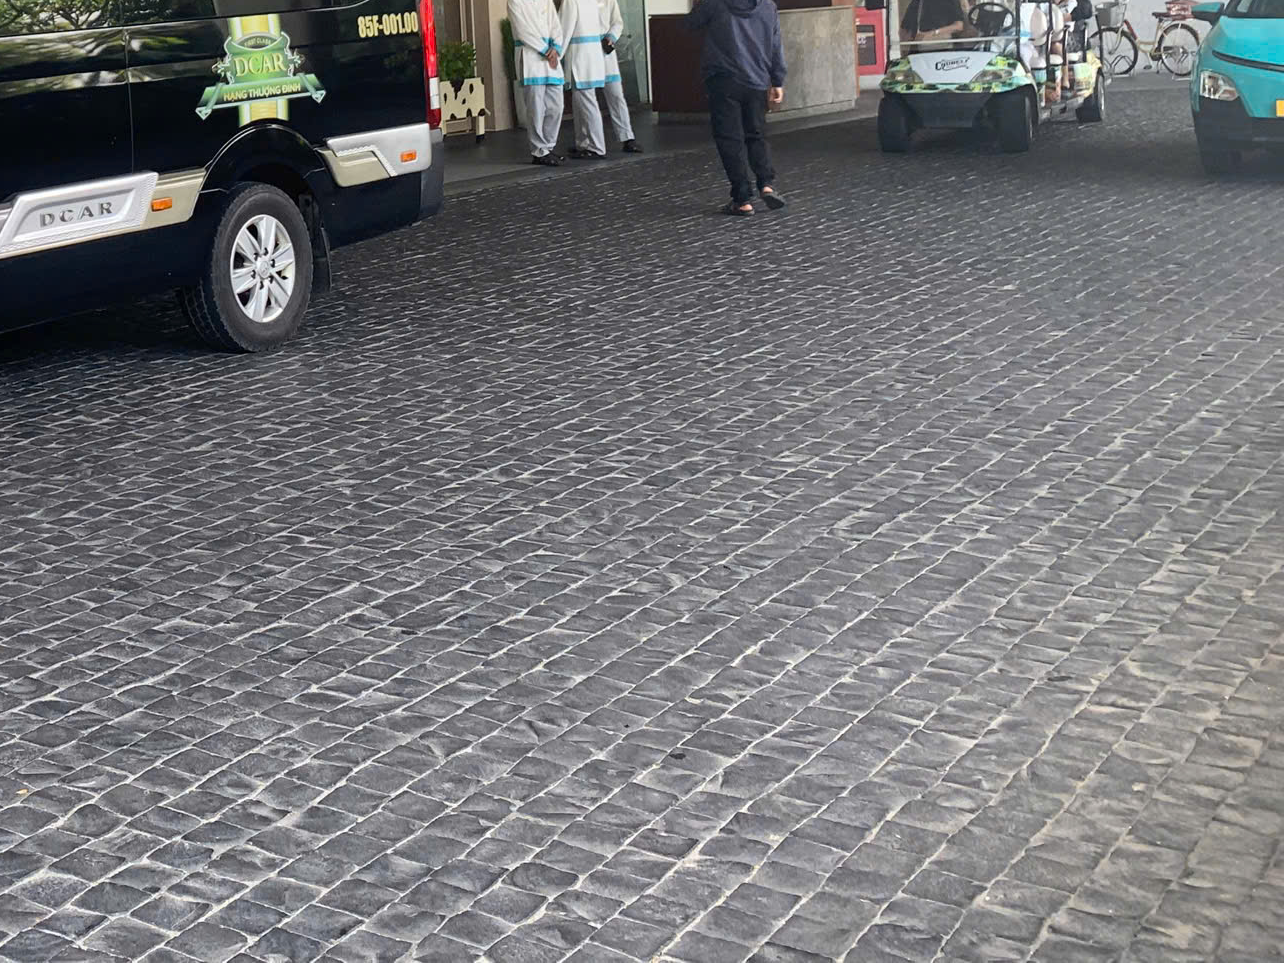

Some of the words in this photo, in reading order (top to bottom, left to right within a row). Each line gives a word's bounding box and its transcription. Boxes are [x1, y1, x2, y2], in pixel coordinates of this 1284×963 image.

[357, 11, 418, 38] 85F-001.00
[234, 52, 287, 77] DCAR
[40, 202, 112, 227] DCAR
